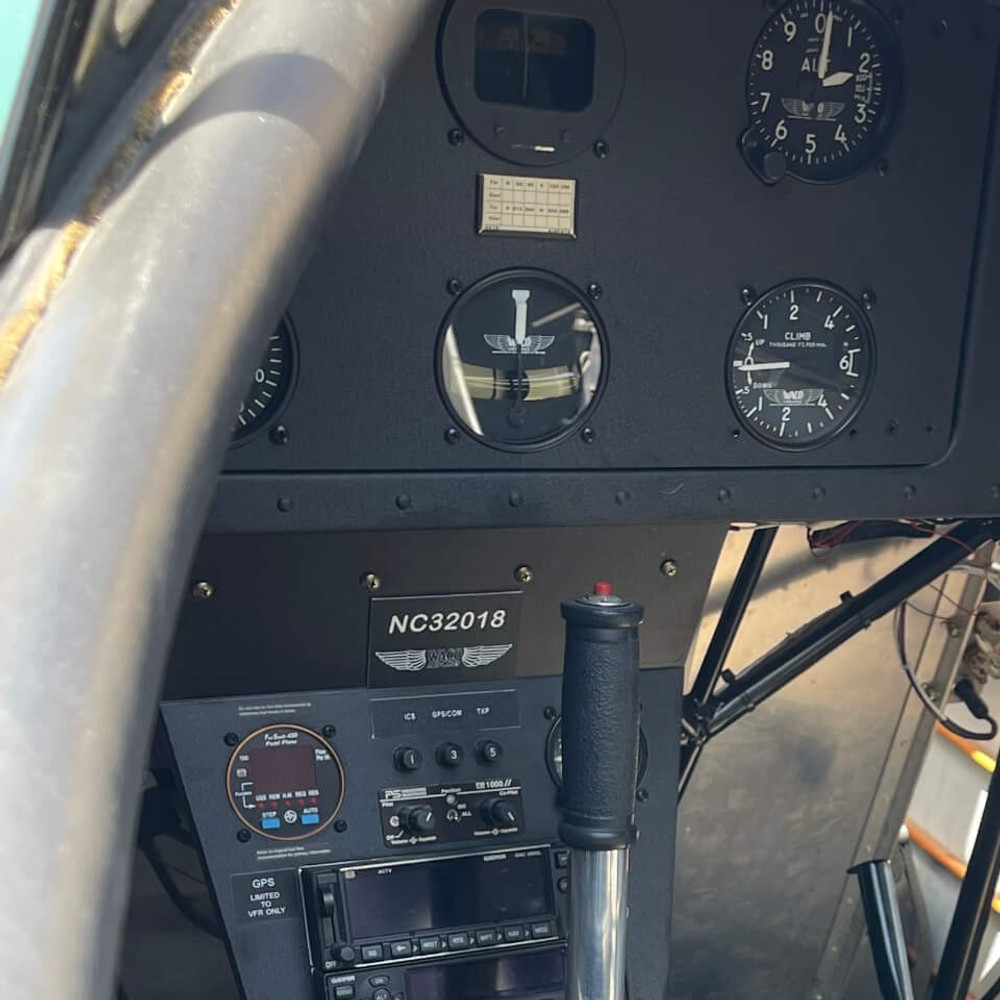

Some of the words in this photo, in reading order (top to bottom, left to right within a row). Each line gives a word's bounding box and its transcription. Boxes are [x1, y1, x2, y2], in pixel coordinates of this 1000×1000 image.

[815, 13, 826, 34] 0
[784, 21, 797, 42] 9
[847, 26, 853, 47] 1
[762, 50, 773, 70] 8
[859, 53, 870, 73] 2
[760, 92, 771, 112] 7
[854, 103, 867, 123] 3
[775, 119, 788, 140] 6
[834, 124, 847, 141] 4
[805, 133, 817, 153] 5
[790, 304, 799, 320] 2
[764, 314, 768, 330] 1
[824, 315, 835, 329] 4
[784, 332, 812, 341] CLIMB
[839, 356, 850, 370] 6
[759, 396, 763, 411] 1
[817, 394, 828, 407] 4
[782, 407, 791, 421] 2
[388, 609, 506, 635] NC32018
[403, 712, 416, 720] ICS
[431, 709, 463, 719] GPS/COM
[451, 750, 458, 760] 3
[489, 747, 497, 757] 5
[303, 807, 318, 815] AUTO
[252, 877, 276, 889] GPS
[250, 891, 281, 902] LIMITED
[260, 900, 272, 908] TO
[247, 909, 264, 918] VFR
[265, 906, 286, 916] ONLY
